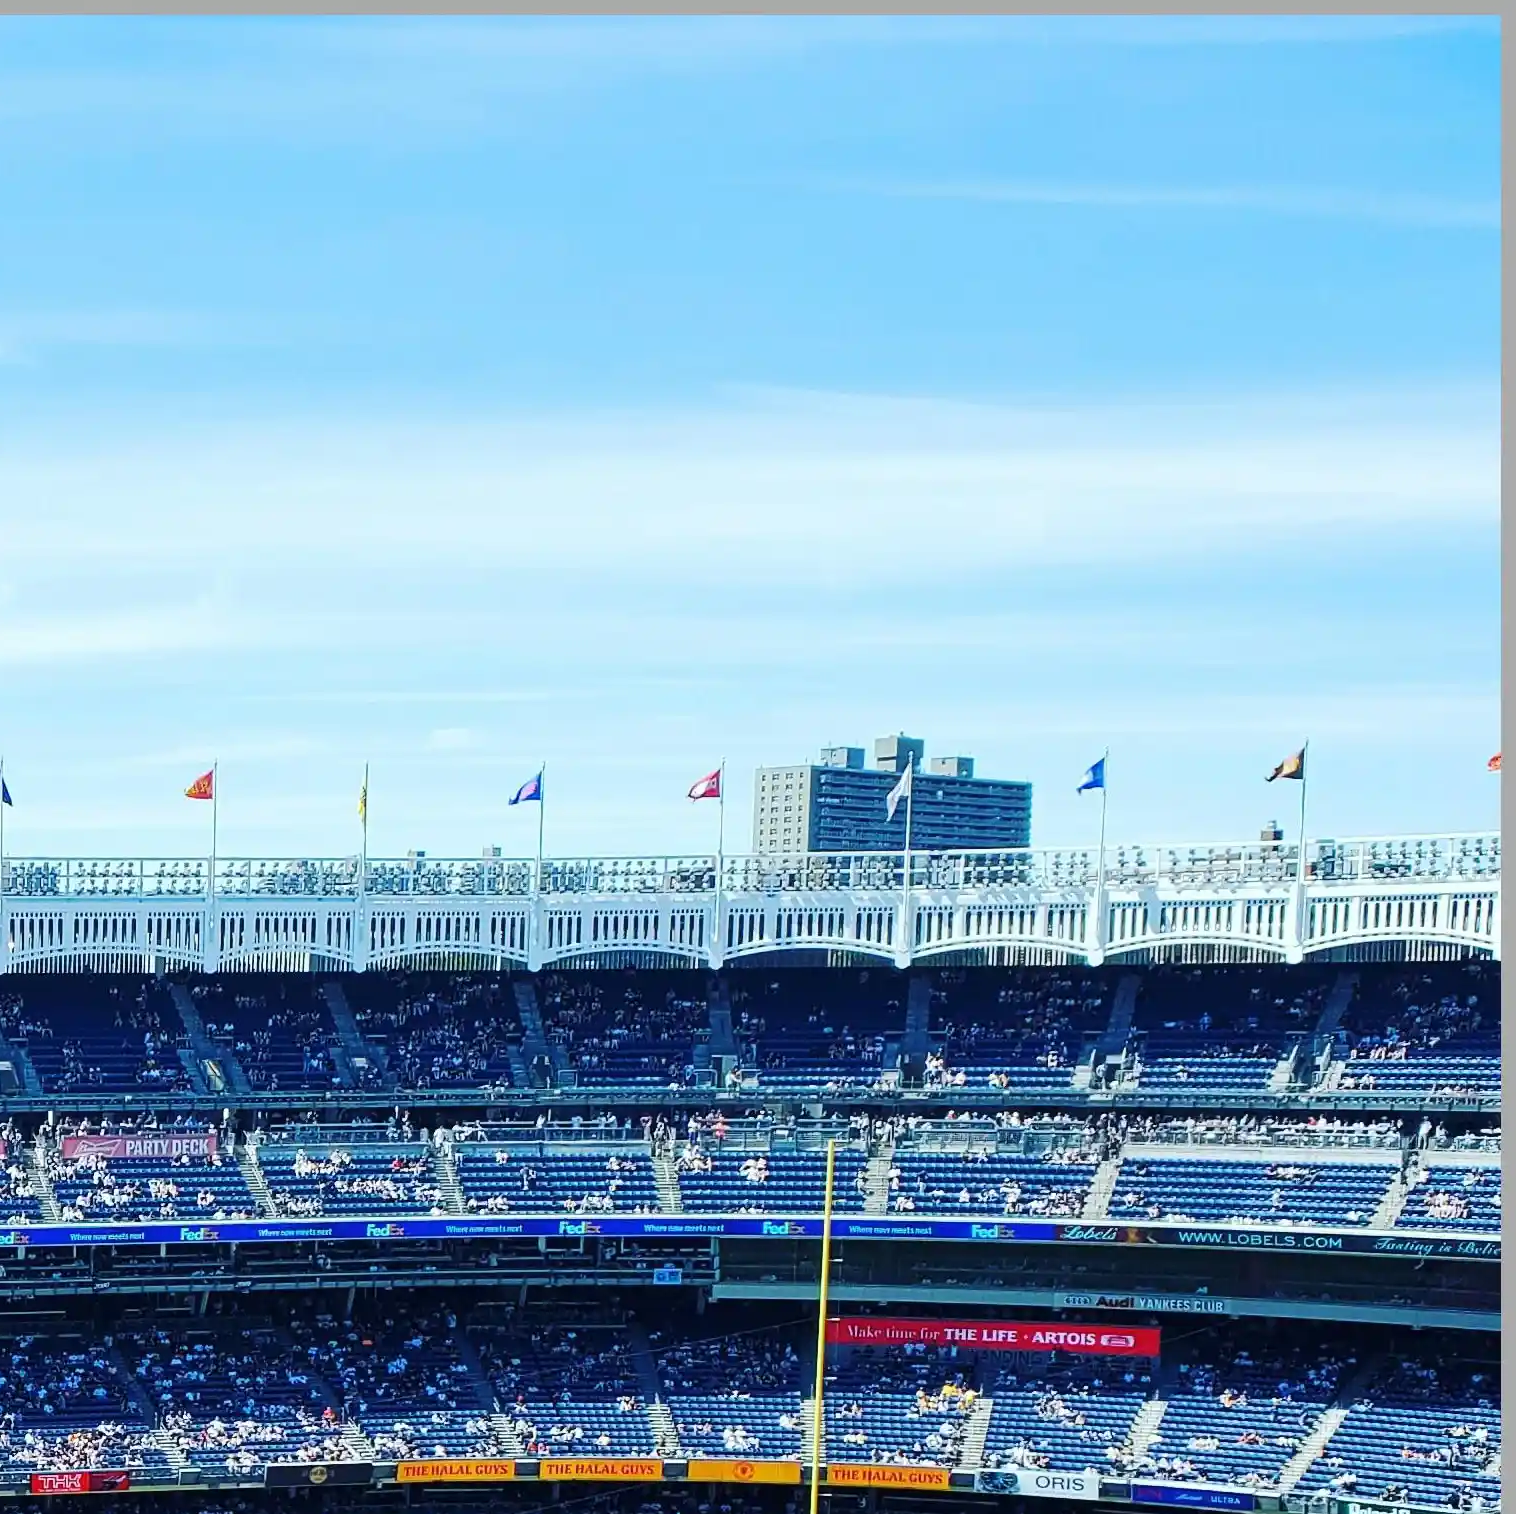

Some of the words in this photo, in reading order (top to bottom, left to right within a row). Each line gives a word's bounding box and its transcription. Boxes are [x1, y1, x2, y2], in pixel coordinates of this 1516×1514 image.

[126, 1140, 169, 1156] PARTY
[171, 1139, 209, 1155] DECK
[180, 1227, 219, 1241] FedEx
[366, 1223, 404, 1237] FedEx
[559, 1221, 601, 1235] FedEx
[763, 1221, 805, 1235] FedEx
[971, 1224, 1015, 1239] FedEx
[1178, 1231, 1343, 1250] WWW.LOBELS.COM
[1373, 1237, 1433, 1255] Tasting
[1438, 1242, 1452, 1253] is
[1095, 1295, 1135, 1309] Audi
[1139, 1297, 1190, 1311] YANKEES
[1193, 1299, 1225, 1313] CLUB
[848, 1324, 883, 1339] Make
[885, 1325, 918, 1340] time
[920, 1326, 941, 1340] for
[943, 1327, 978, 1342] THE
[981, 1329, 1019, 1343] LIFE
[1031, 1331, 1096, 1346] ARTOIS
[403, 1466, 430, 1477] THE
[431, 1465, 472, 1477] HALAL
[475, 1464, 509, 1476] GUYS
[546, 1464, 572, 1476] THE
[575, 1464, 618, 1476] HALAL
[620, 1464, 655, 1476] GUYS
[832, 1469, 860, 1481] THE
[862, 1470, 907, 1482] HALAL
[908, 1472, 944, 1484] GUYS
[38, 1473, 82, 1489] THK
[1035, 1475, 1086, 1492] ORIS
[1210, 1494, 1241, 1505] ULTRA
